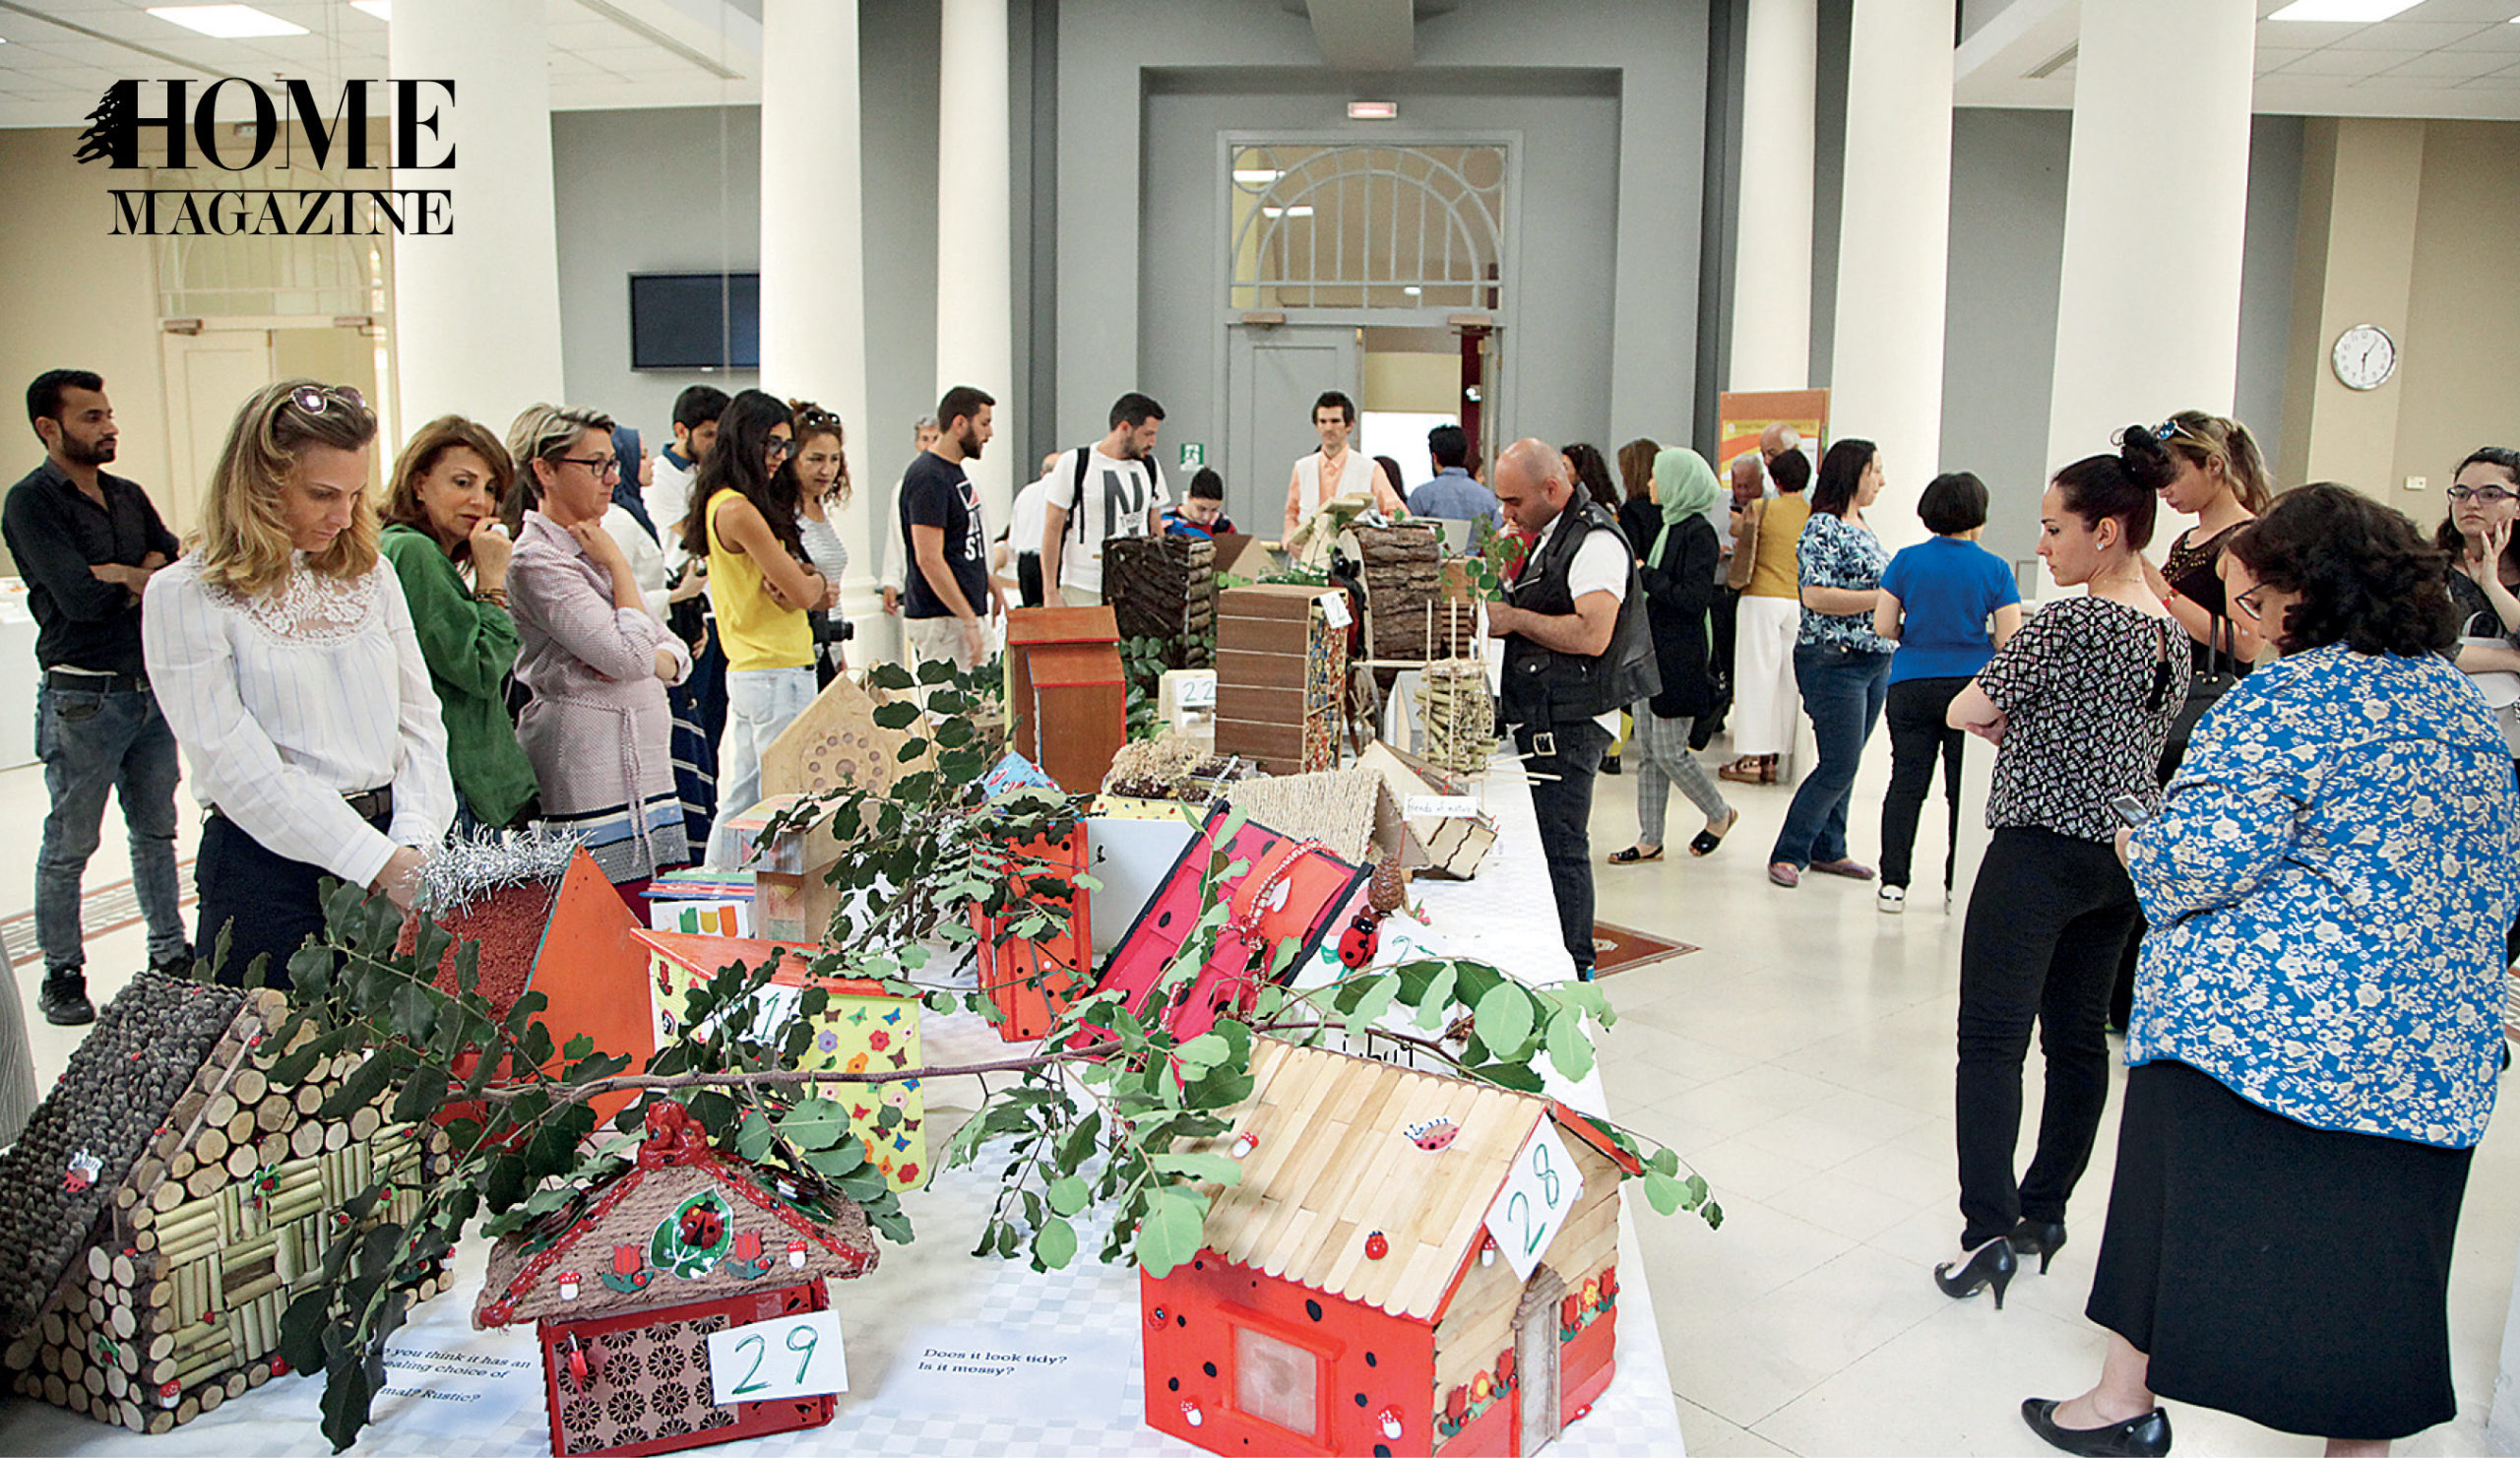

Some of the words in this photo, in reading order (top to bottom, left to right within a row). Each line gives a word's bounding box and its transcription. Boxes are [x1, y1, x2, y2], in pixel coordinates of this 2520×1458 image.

[1182, 680, 1217, 702] 22
[1508, 1143, 1560, 1258] 28
[392, 1349, 423, 1359] you
[425, 1351, 466, 1362] think
[467, 1354, 480, 1363] it
[479, 1355, 508, 1366] has
[510, 1361, 531, 1369] an
[731, 1324, 819, 1395] 29
[923, 1349, 966, 1360] Does
[971, 1351, 981, 1361] it
[985, 1352, 1021, 1363] look
[1026, 1355, 1068, 1366] tidy?
[383, 1360, 432, 1373] ealing
[434, 1364, 488, 1376] choice
[489, 1369, 510, 1378] of
[918, 1362, 932, 1370] Is
[937, 1363, 948, 1371] it
[952, 1364, 1015, 1376] messy?
[380, 1386, 422, 1397] mal?
[421, 1388, 482, 1403] Rustic?
